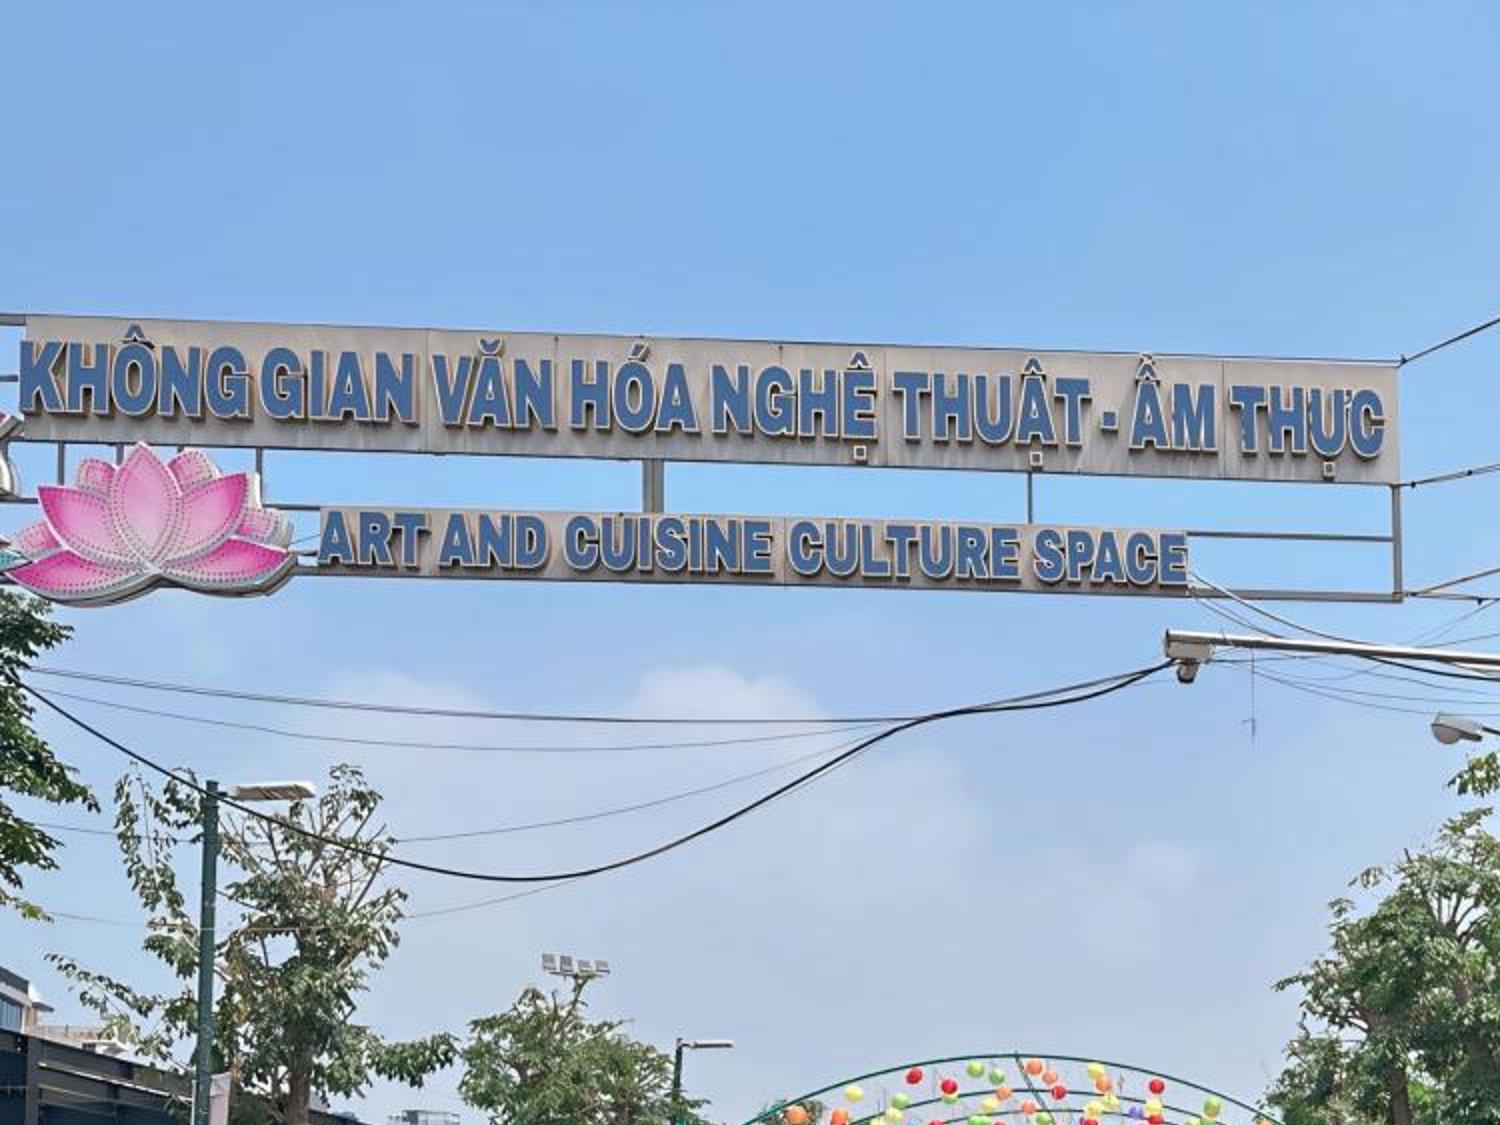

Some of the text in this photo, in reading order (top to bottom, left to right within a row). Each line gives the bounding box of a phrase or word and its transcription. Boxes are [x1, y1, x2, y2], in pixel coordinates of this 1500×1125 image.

[19, 325, 253, 419] KHÔNG
[259, 347, 418, 424] GIAN
[431, 339, 556, 430] VĂN
[569, 346, 700, 434] HÓA
[710, 351, 878, 462] NGHỆ
[891, 357, 1091, 468] THUẬT
[1229, 384, 1386, 479] THỰC
[317, 510, 1189, 586] ART AND CUISINE CULTURE SPACE
